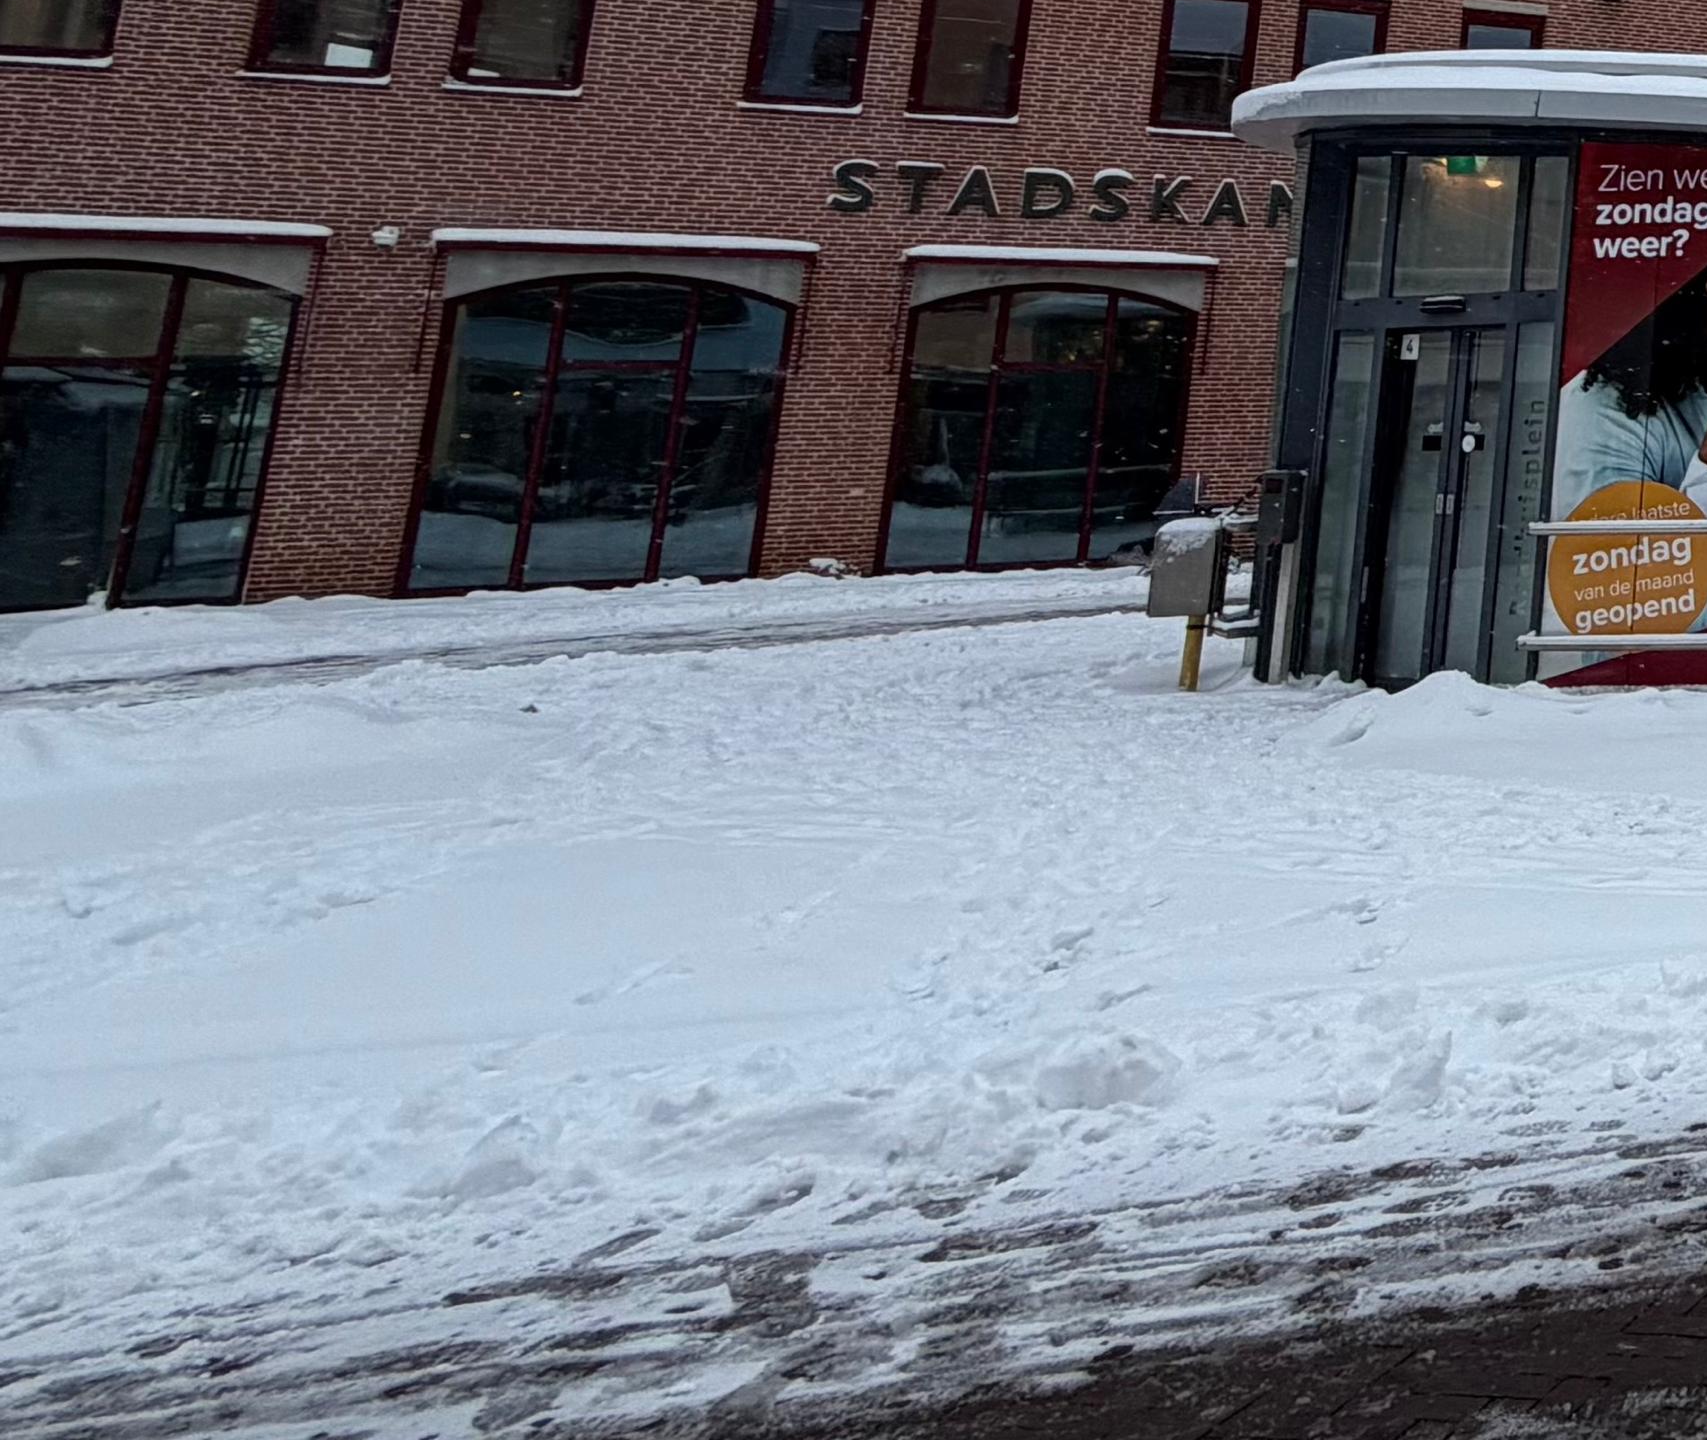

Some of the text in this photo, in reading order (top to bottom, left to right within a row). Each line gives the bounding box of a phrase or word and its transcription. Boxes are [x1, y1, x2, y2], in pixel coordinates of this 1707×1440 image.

[1598, 164, 1664, 192] Zien
[1592, 228, 1690, 259] weer?
[1572, 536, 1692, 574] zondag
[1575, 568, 1694, 601] van de maand
[1575, 588, 1696, 634] geopend
